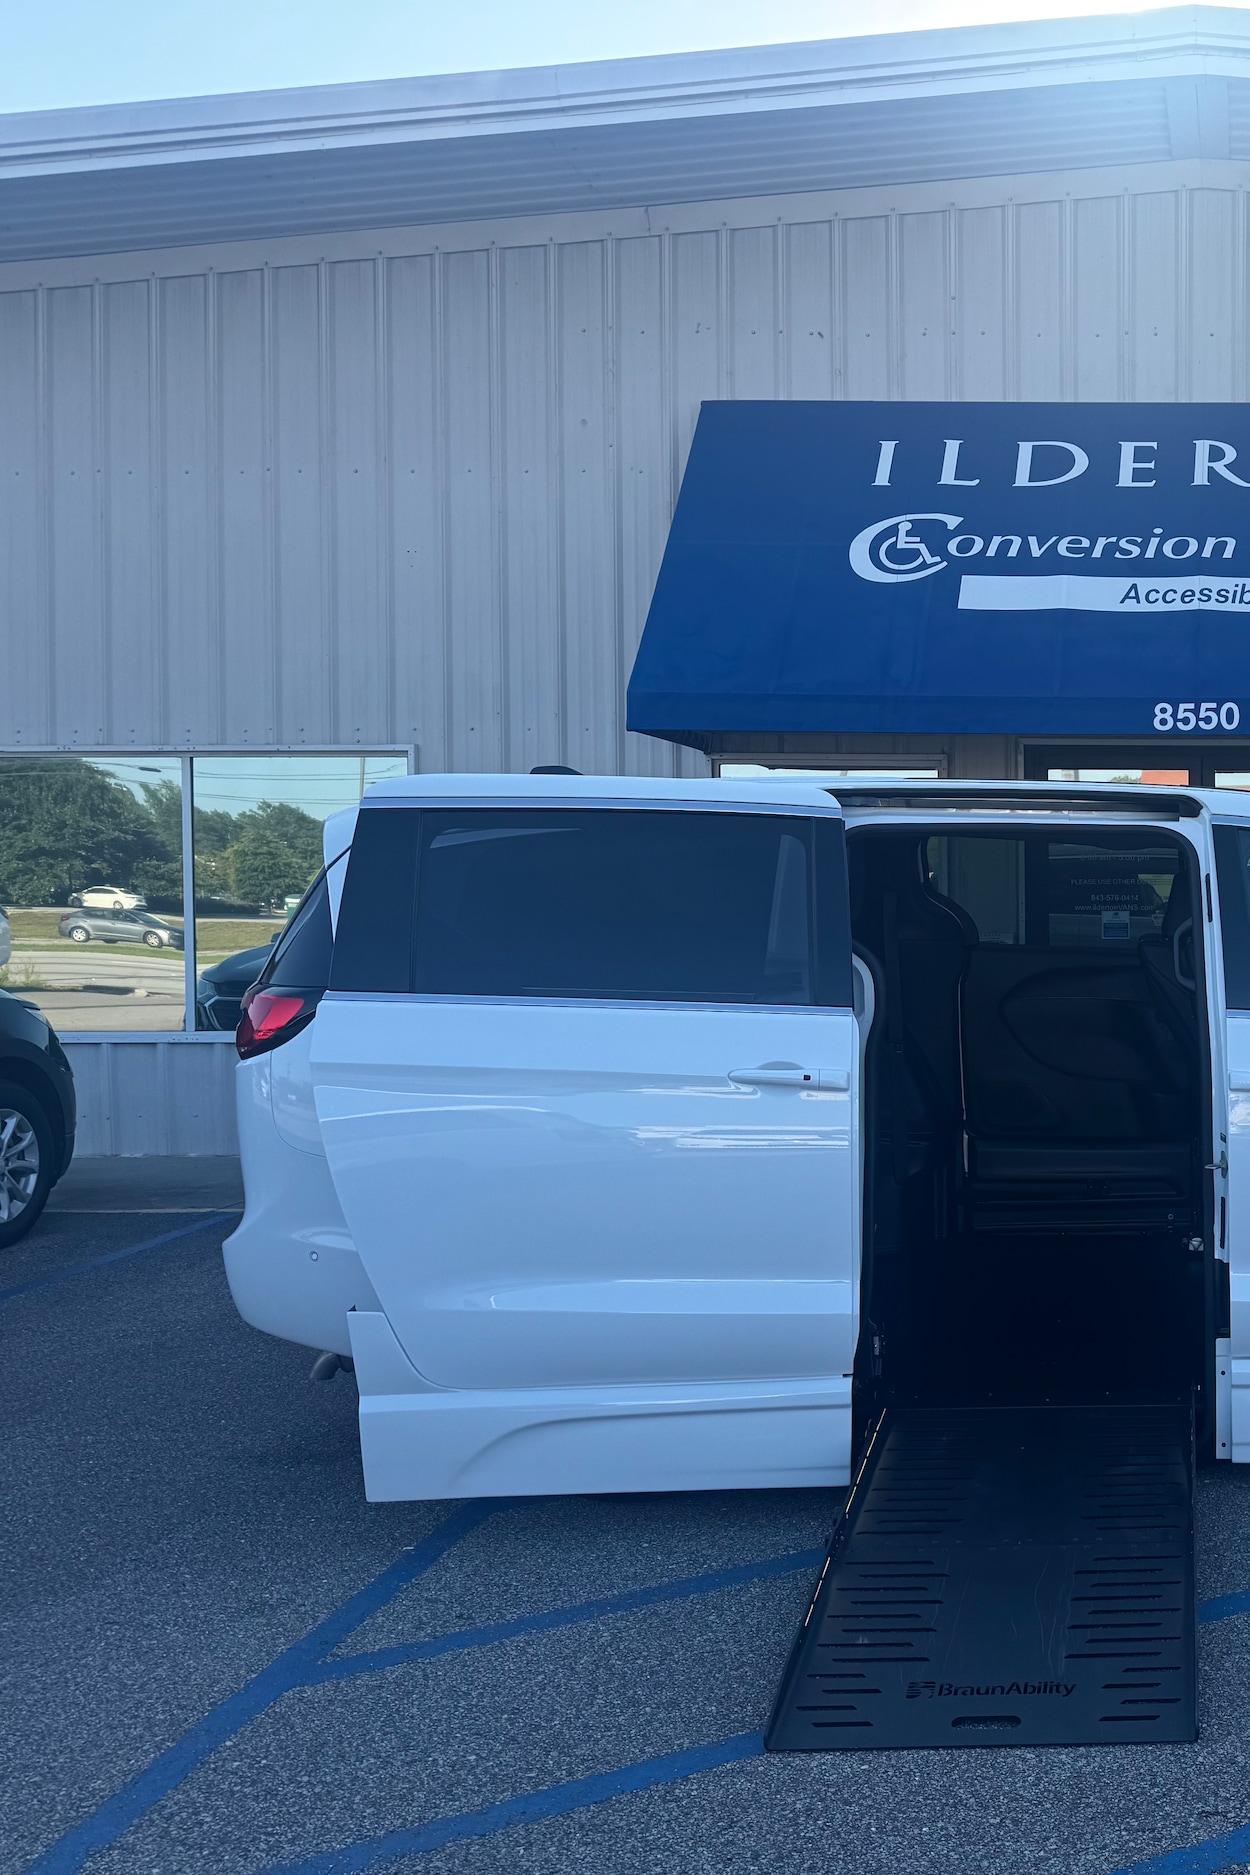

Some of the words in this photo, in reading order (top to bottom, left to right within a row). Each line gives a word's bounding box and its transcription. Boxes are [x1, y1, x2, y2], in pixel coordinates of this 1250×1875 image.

[848, 513, 1237, 583] Conversion
[1153, 702, 1241, 731] 8550
[938, 1681, 1077, 1698] BraunAbility
